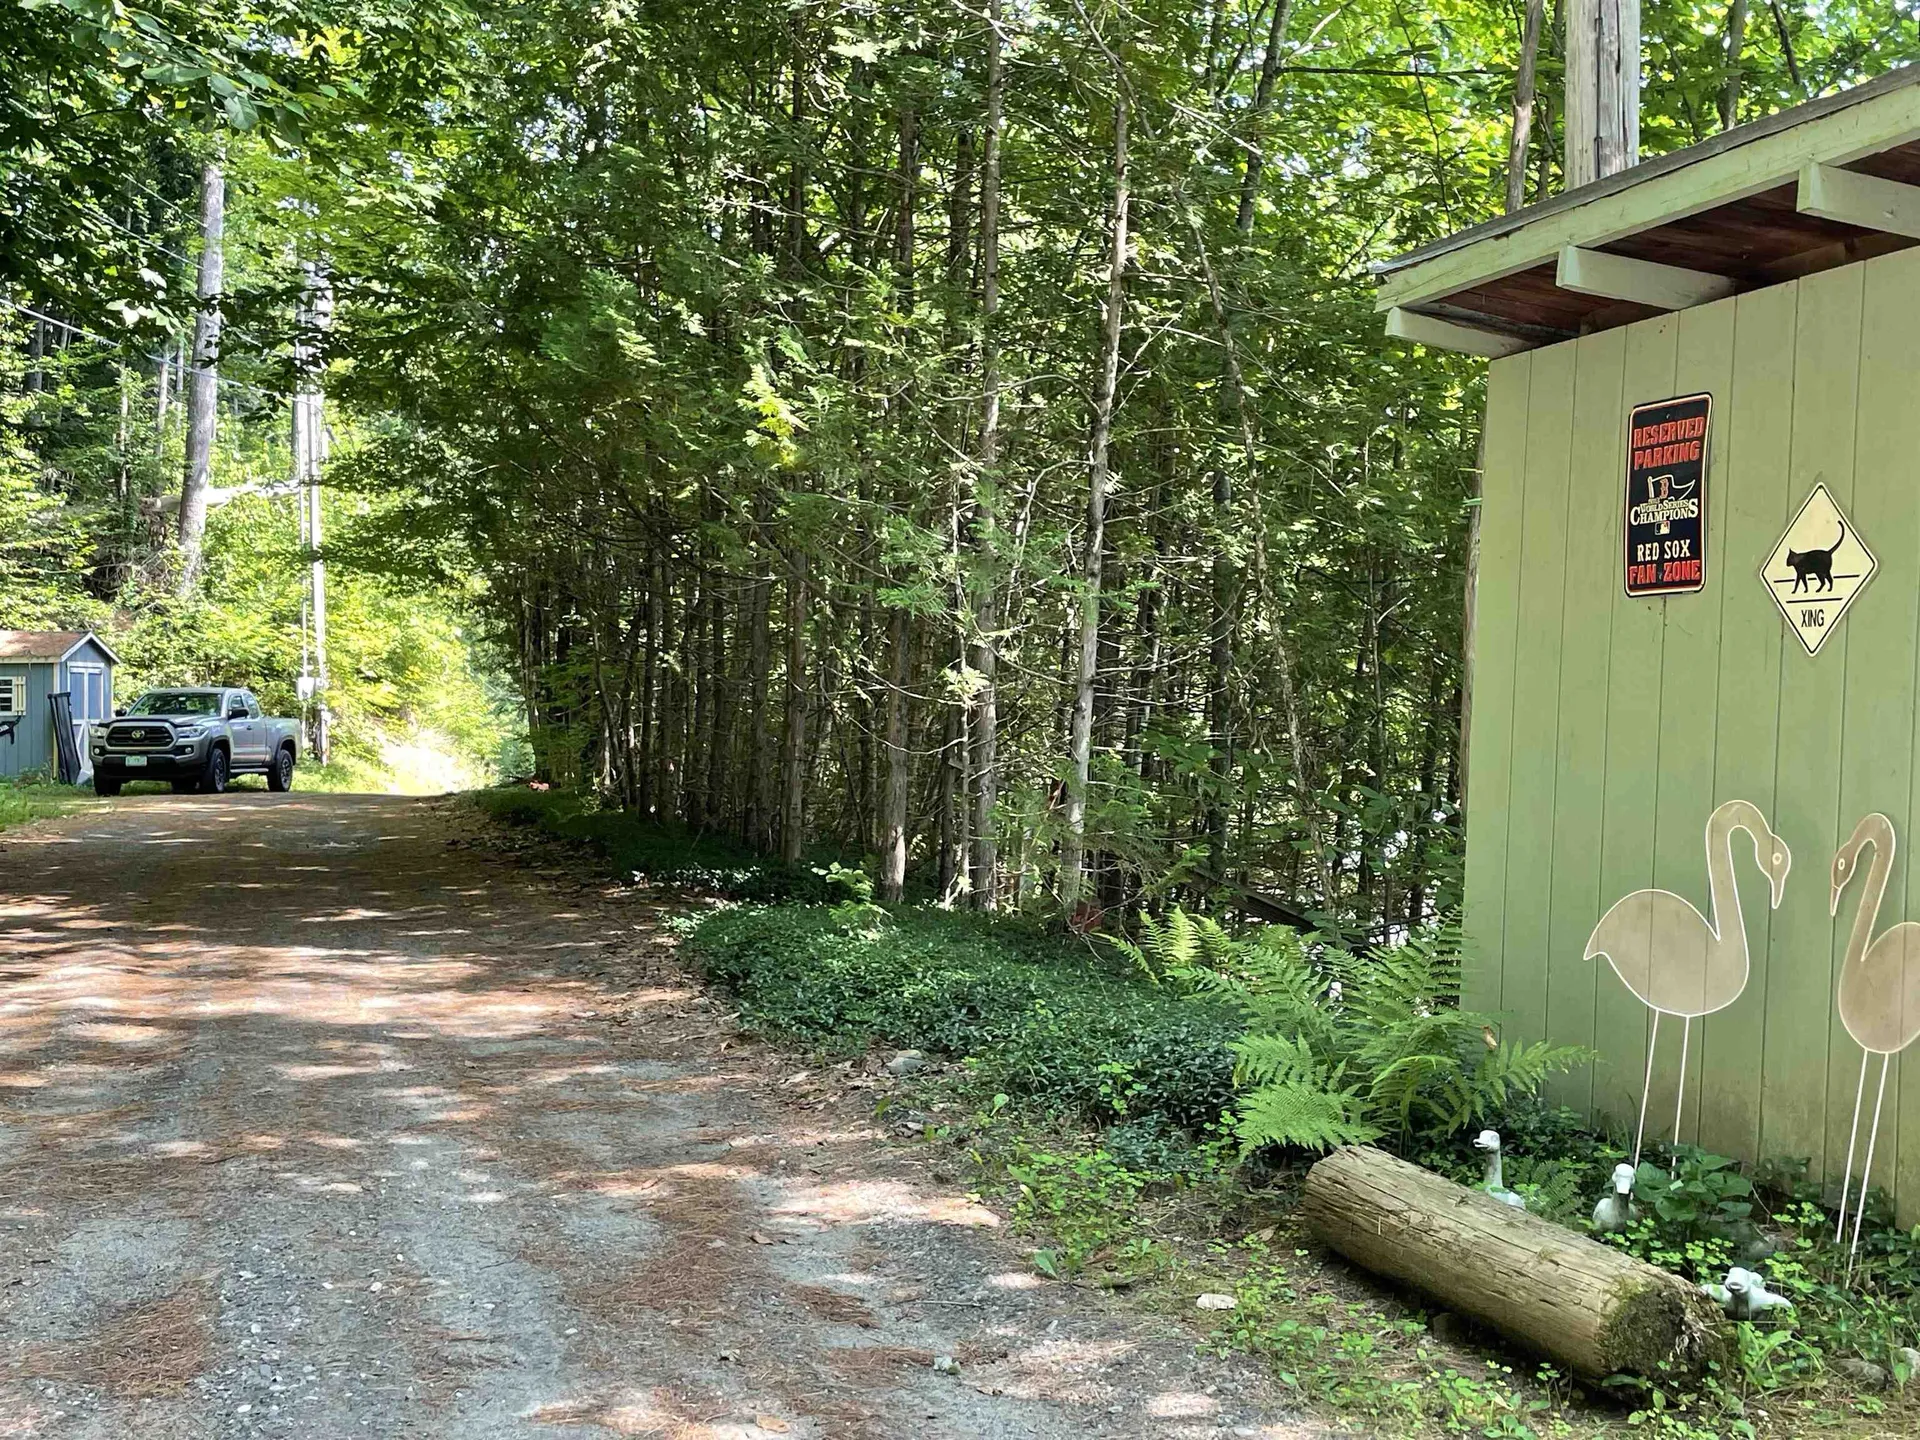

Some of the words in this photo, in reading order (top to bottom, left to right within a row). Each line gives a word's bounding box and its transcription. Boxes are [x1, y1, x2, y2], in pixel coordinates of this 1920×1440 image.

[1634, 417, 1705, 448] RESERVED
[1634, 440, 1700, 470] PARKING
[1630, 498, 1698, 526] CHAMPIONS
[1640, 503, 1663, 513] WORLD
[1663, 499, 1688, 510] SERIES
[1637, 542, 1659, 562] RED
[1664, 539, 1690, 559] SOX
[1629, 565, 1656, 585] FAN
[1663, 560, 1700, 582] ZONE
[1801, 609, 1824, 628] XING
